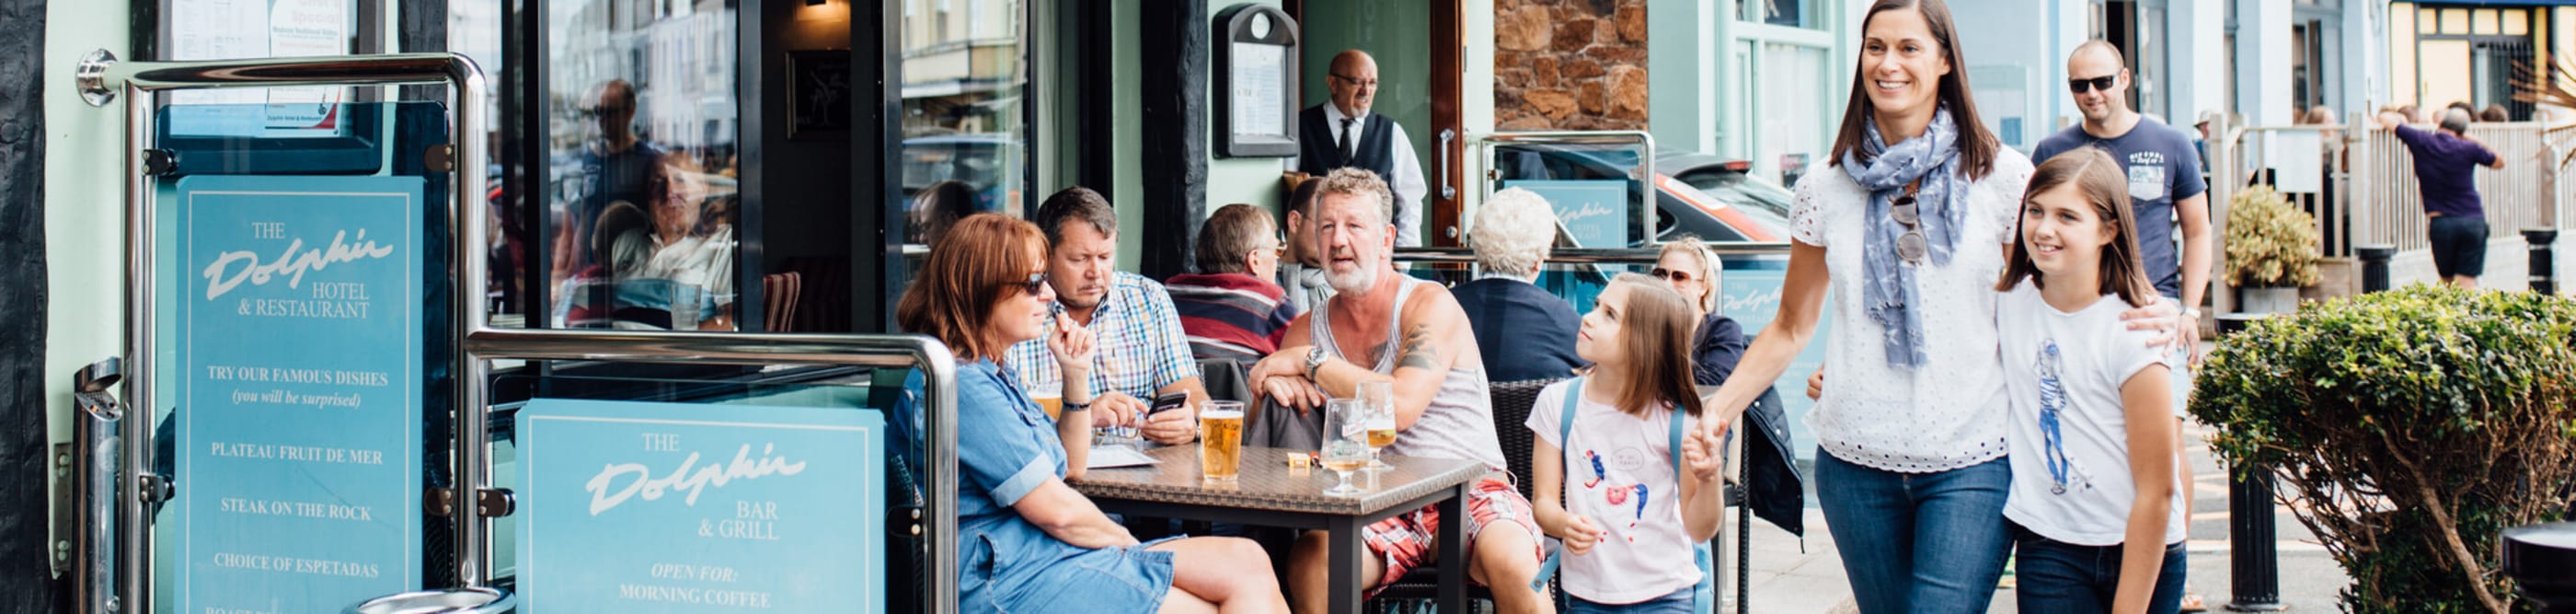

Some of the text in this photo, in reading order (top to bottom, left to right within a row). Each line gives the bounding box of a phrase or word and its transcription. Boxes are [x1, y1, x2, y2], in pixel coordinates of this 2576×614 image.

[251, 222, 286, 239] THE
[203, 228, 394, 301] Dolphin
[312, 282, 369, 300] HOTEL
[237, 298, 370, 319] & RESTAURANT
[207, 365, 389, 387] TRY OUR FAMOUS DISHES
[232, 388, 362, 410] (you will be surprised)
[211, 442, 383, 465] PLATEAU FRUIT DE MER
[641, 433, 681, 452] THE
[585, 442, 806, 516] Dolphin
[221, 497, 372, 521] STEAK ON THE ROCK
[737, 501, 779, 520] BAR
[698, 518, 780, 540] & GRILL
[213, 552, 379, 578] CHOICE OF ESPETADAS
[650, 562, 739, 583] OPEN FOR:
[619, 583, 772, 608] MORNING COFFEE
